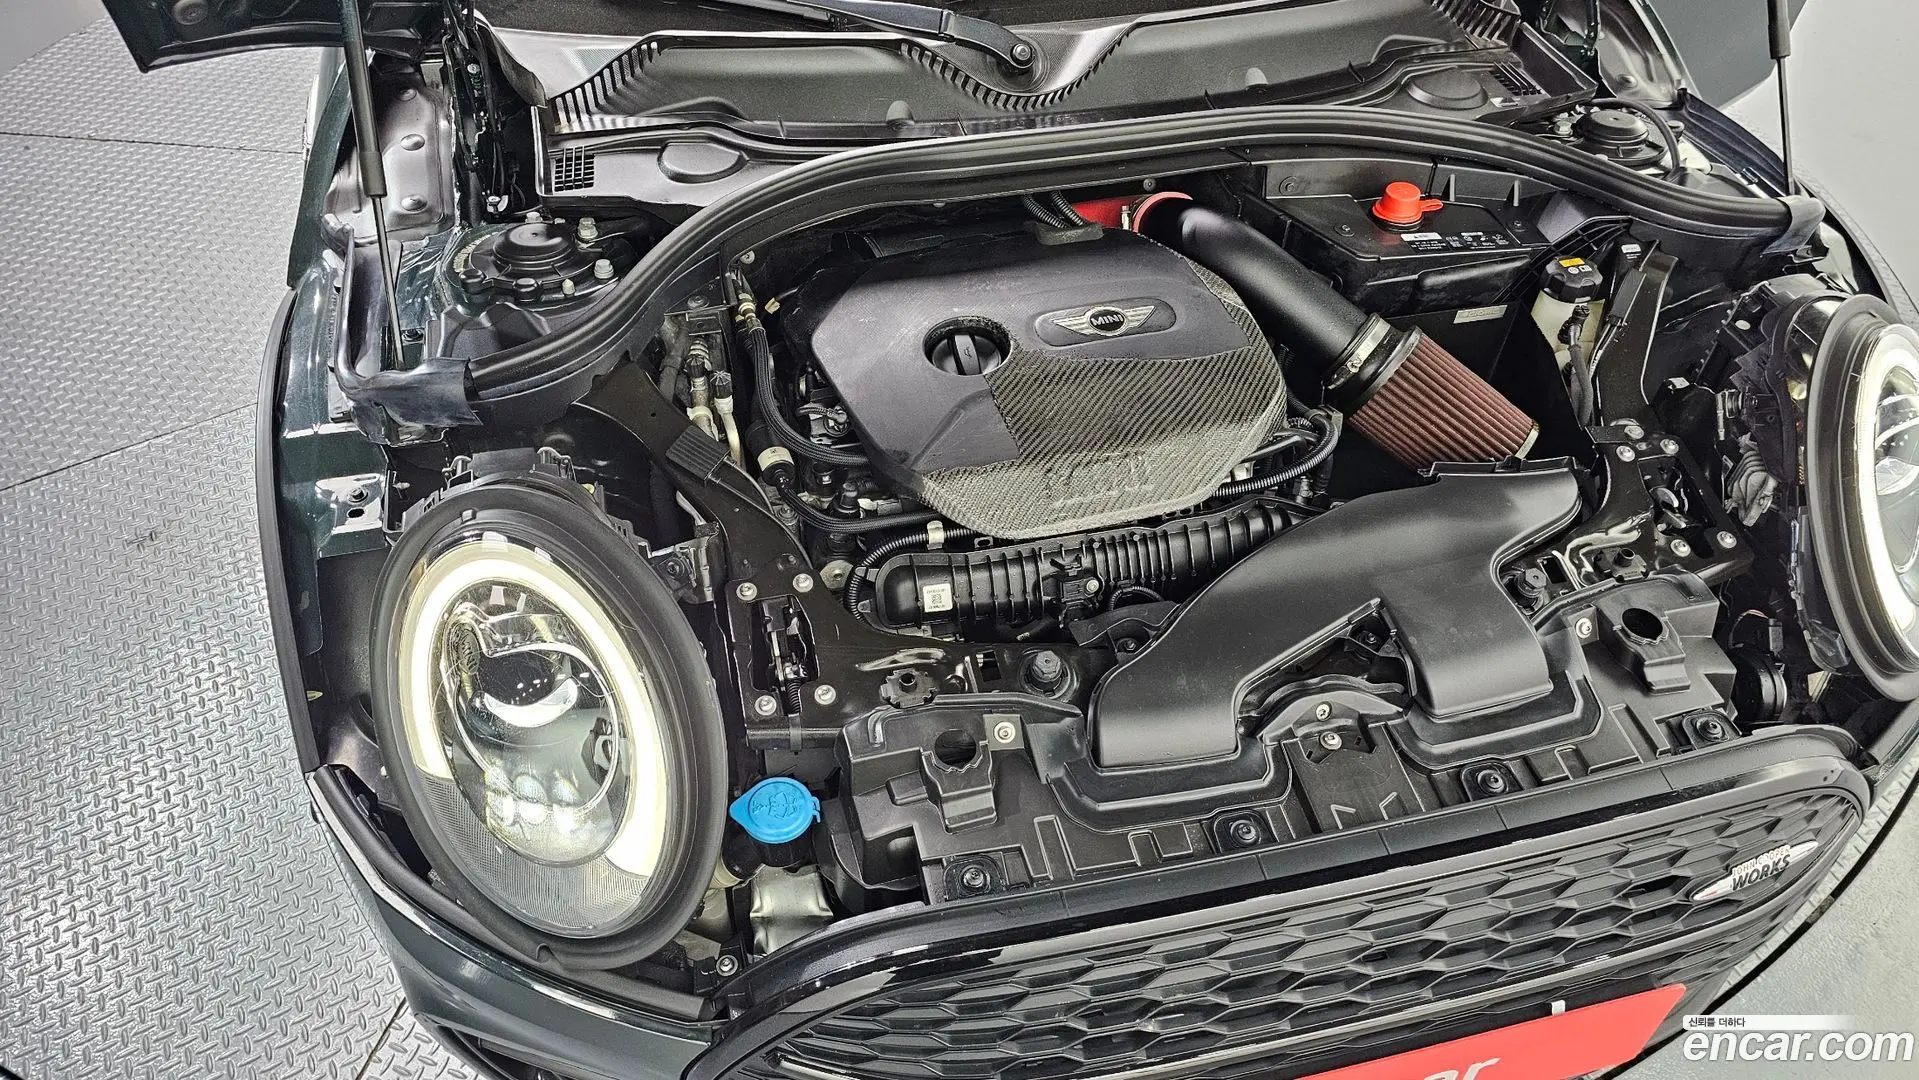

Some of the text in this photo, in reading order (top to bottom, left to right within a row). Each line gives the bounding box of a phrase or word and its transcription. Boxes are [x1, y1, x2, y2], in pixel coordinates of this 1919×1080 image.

[1090, 314, 1124, 326] MINI
[1731, 854, 1791, 891] WORKS
[1732, 859, 1756, 876] JOHN
